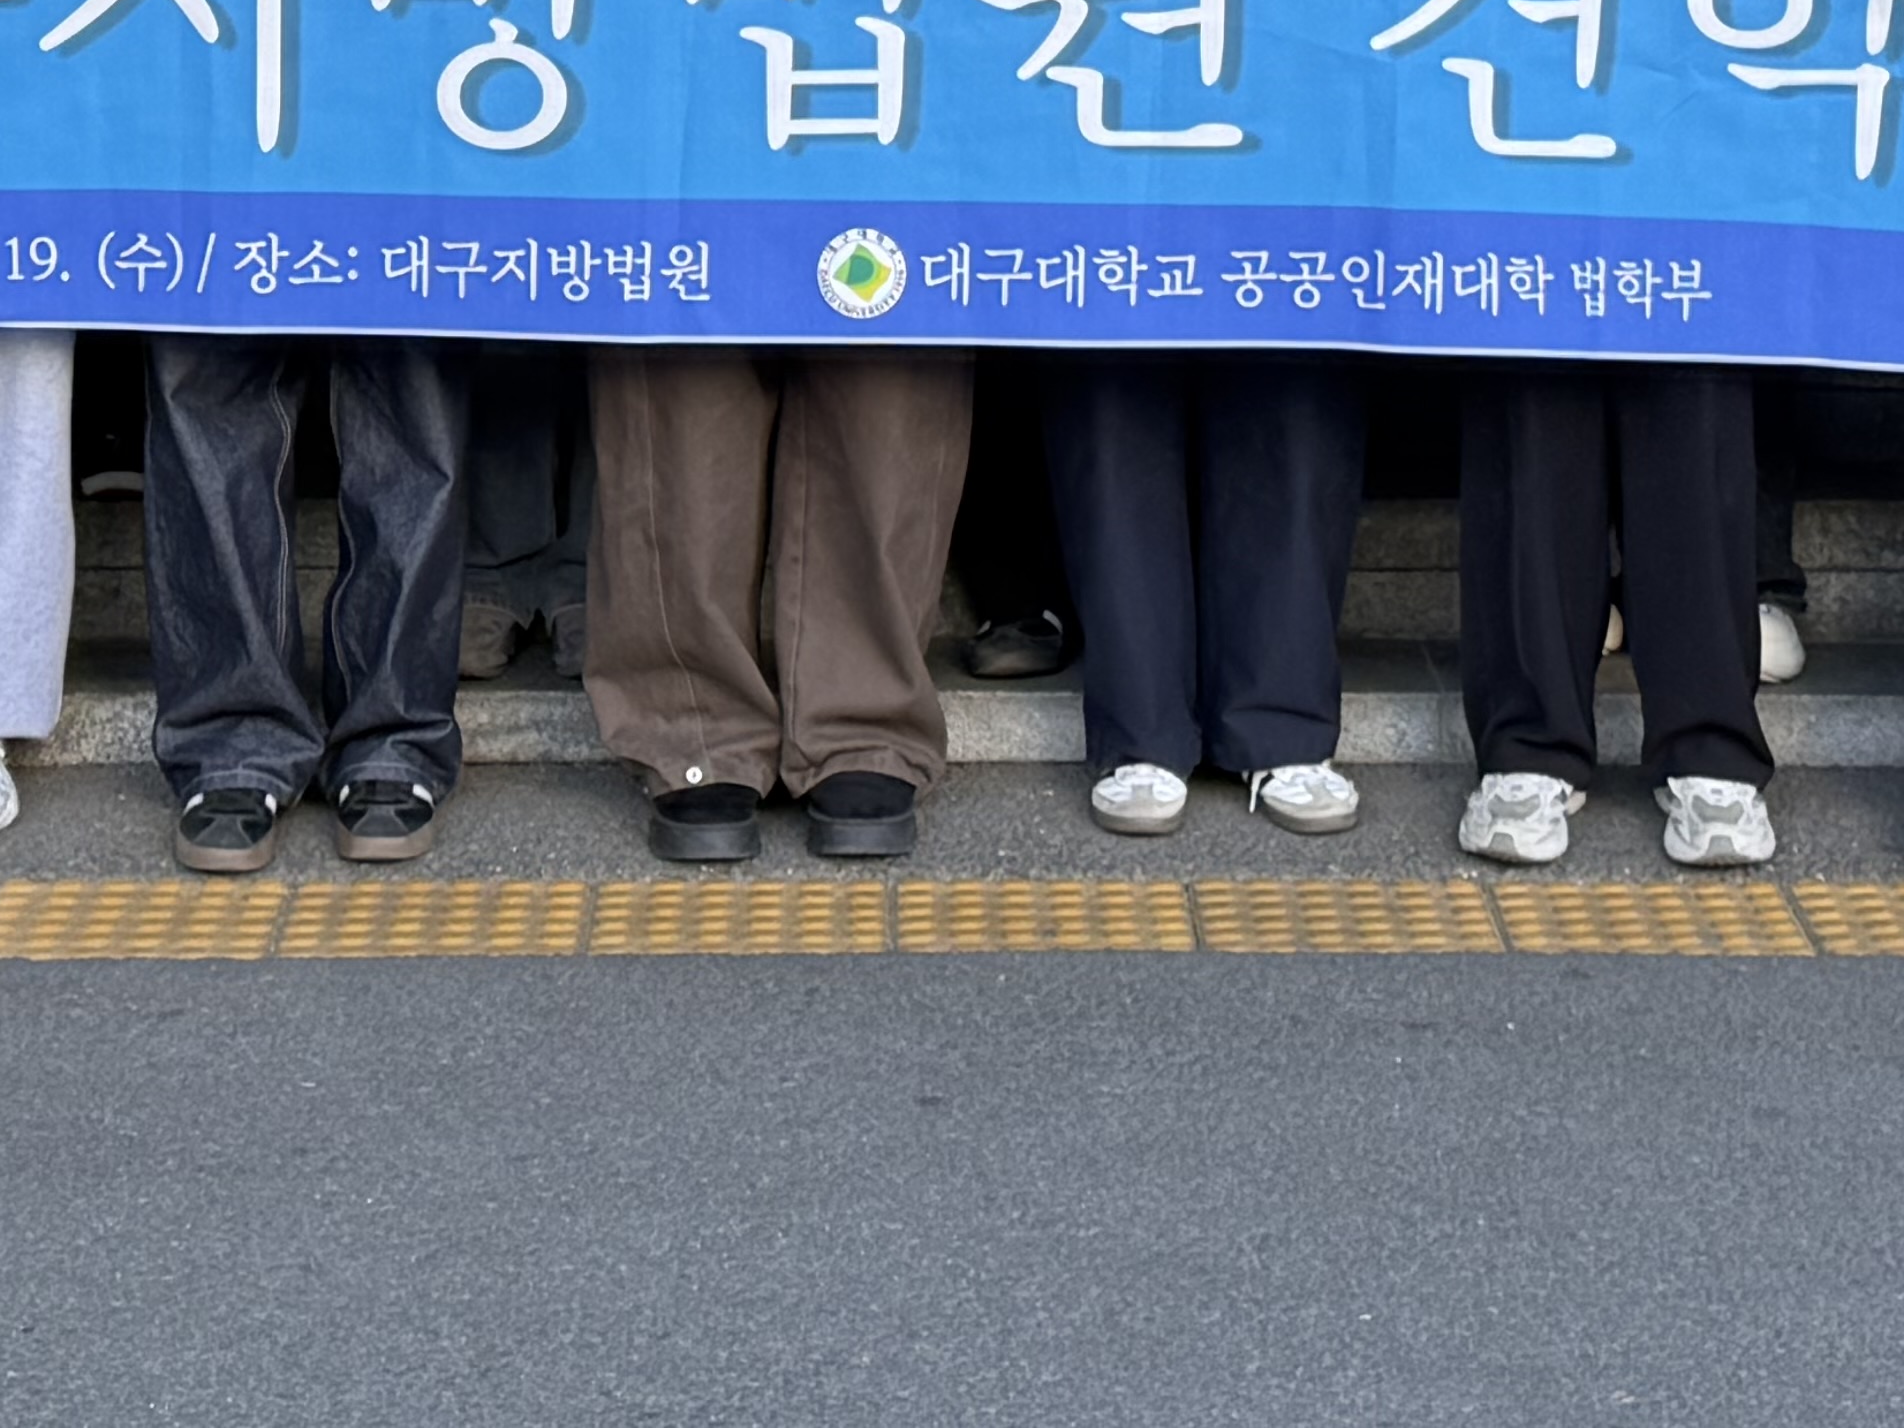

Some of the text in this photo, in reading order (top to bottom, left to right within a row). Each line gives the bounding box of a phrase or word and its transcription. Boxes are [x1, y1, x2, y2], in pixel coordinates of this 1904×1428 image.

[5, 236, 71, 283] 19.
[234, 232, 359, 295] 장소:
[381, 235, 712, 302] 대구지방법원
[920, 242, 1205, 309] 대구대학교
[1221, 250, 1555, 317] 공공인재대학
[1570, 256, 1714, 323] 법학부
